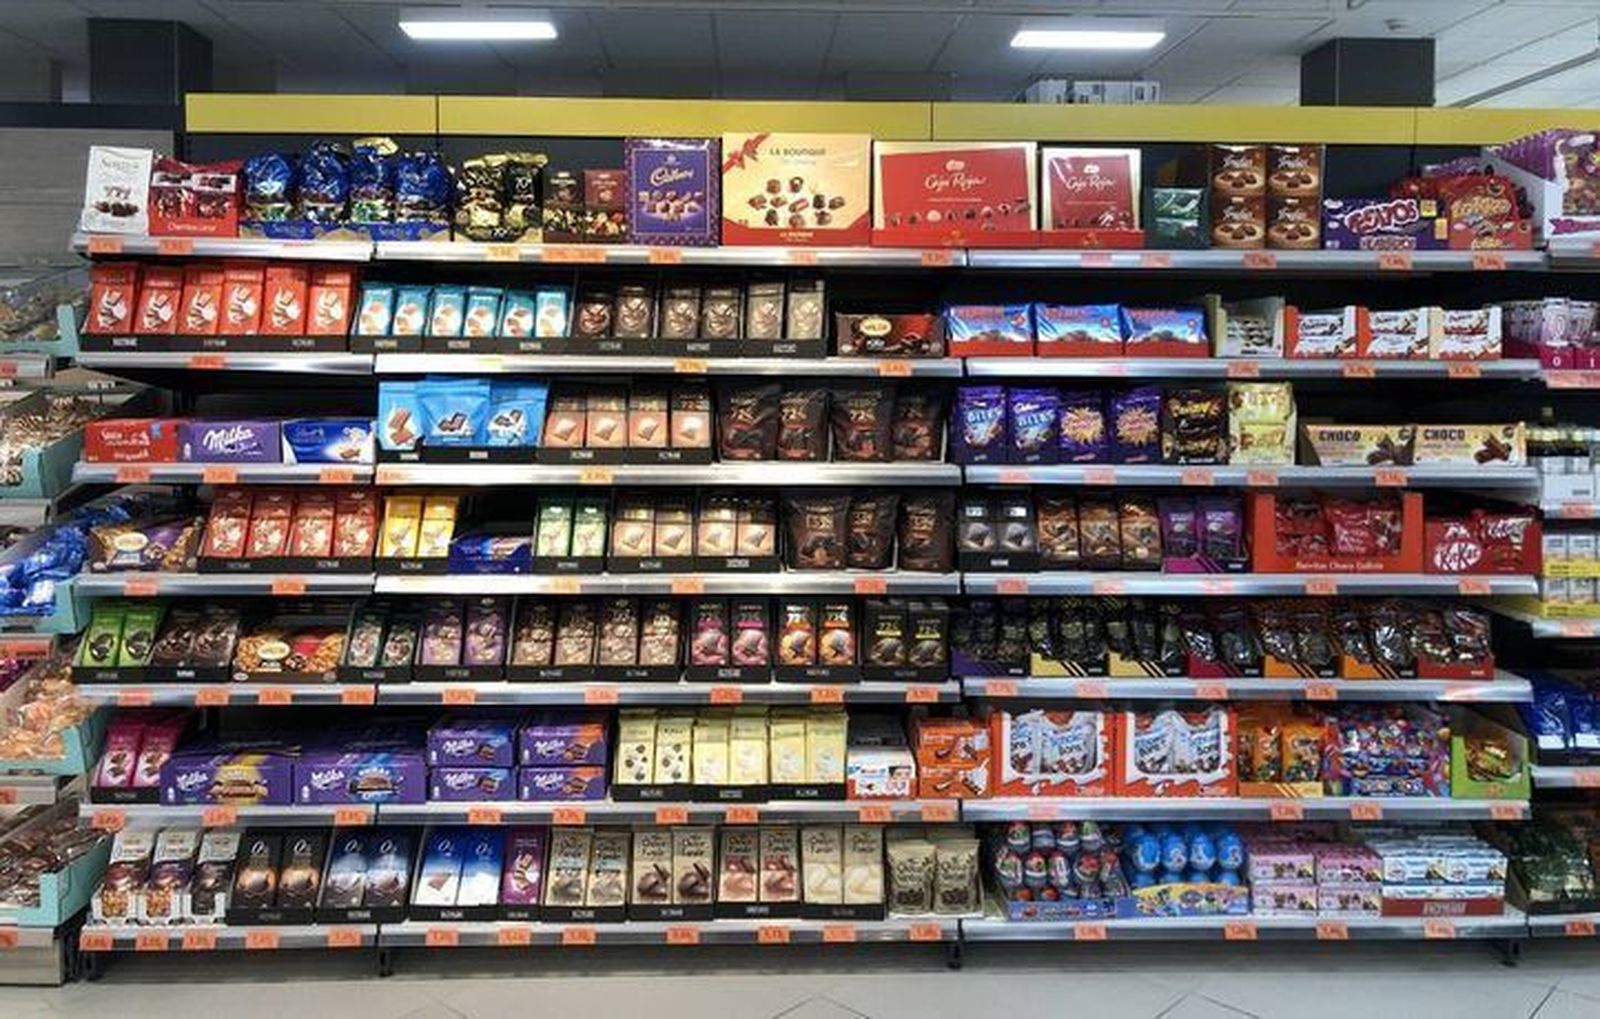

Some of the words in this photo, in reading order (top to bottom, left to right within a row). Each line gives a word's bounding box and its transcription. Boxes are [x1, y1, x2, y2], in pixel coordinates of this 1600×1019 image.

[651, 167, 694, 187] Cadbury
[202, 425, 254, 453] Milka
[1319, 430, 1362, 442] CHOCO
[1423, 429, 1465, 440] CHOCO
[442, 739, 475, 757] Milka
[534, 738, 565, 757] Milka
[176, 772, 209, 791] Milka
[311, 767, 344, 789] Milka
[443, 772, 475, 790] Milka
[534, 771, 564, 790] Milka
